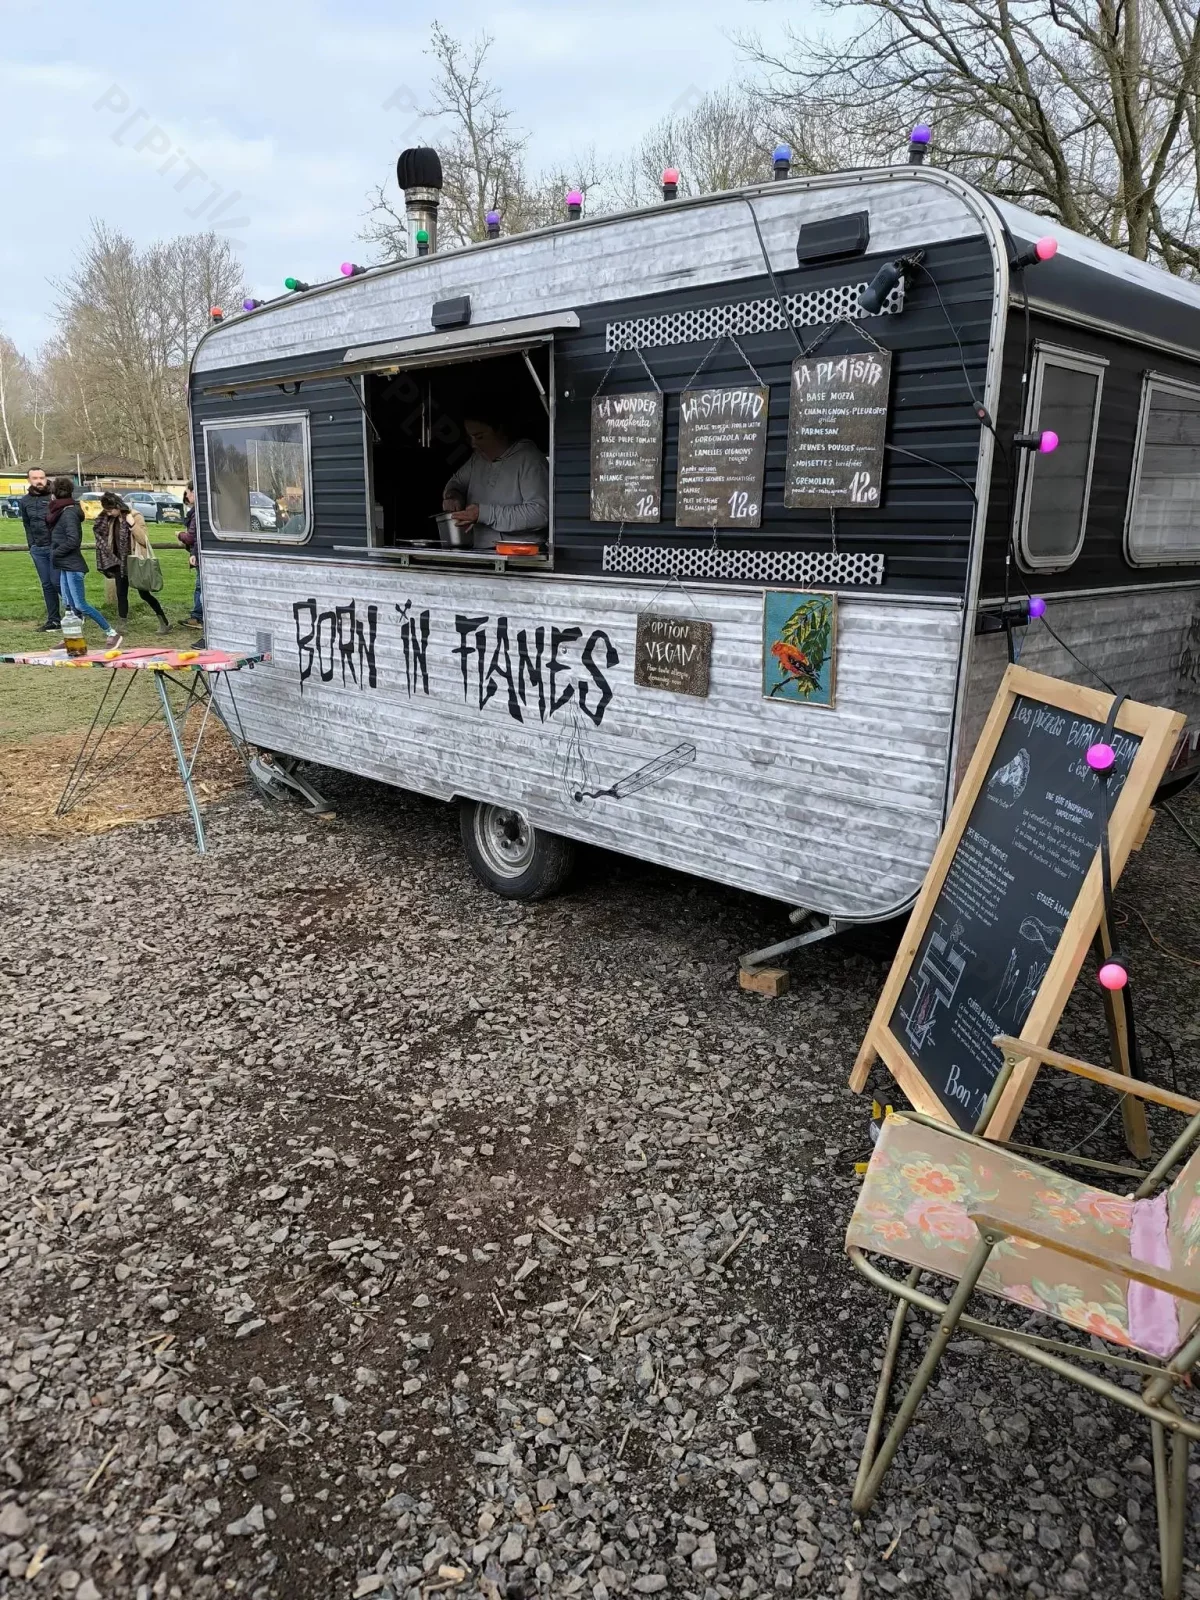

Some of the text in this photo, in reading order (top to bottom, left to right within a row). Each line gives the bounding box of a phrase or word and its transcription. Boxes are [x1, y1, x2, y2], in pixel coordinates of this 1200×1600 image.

[806, 391, 855, 401] BASE MOZZA
[613, 399, 657, 417] WONDER
[681, 390, 765, 424] LA SAPPHO
[606, 414, 651, 432] margherita
[695, 424, 710, 432] BASE
[801, 427, 840, 436] PARMESAN
[694, 433, 757, 443] GORGONZOLA AOP
[694, 447, 753, 457] LAMELLES OIGNONS
[828, 444, 856, 452] POUSSES
[796, 459, 833, 467] NOISETTES
[636, 494, 659, 517] 12e
[727, 491, 758, 518] 12e
[293, 598, 377, 697] BORN
[451, 614, 620, 727] FLAMES
[644, 641, 697, 666] VEGAN
[1012, 698, 1033, 725] Les
[1029, 705, 1066, 737] pizzas
[1110, 733, 1141, 771] FLAM
